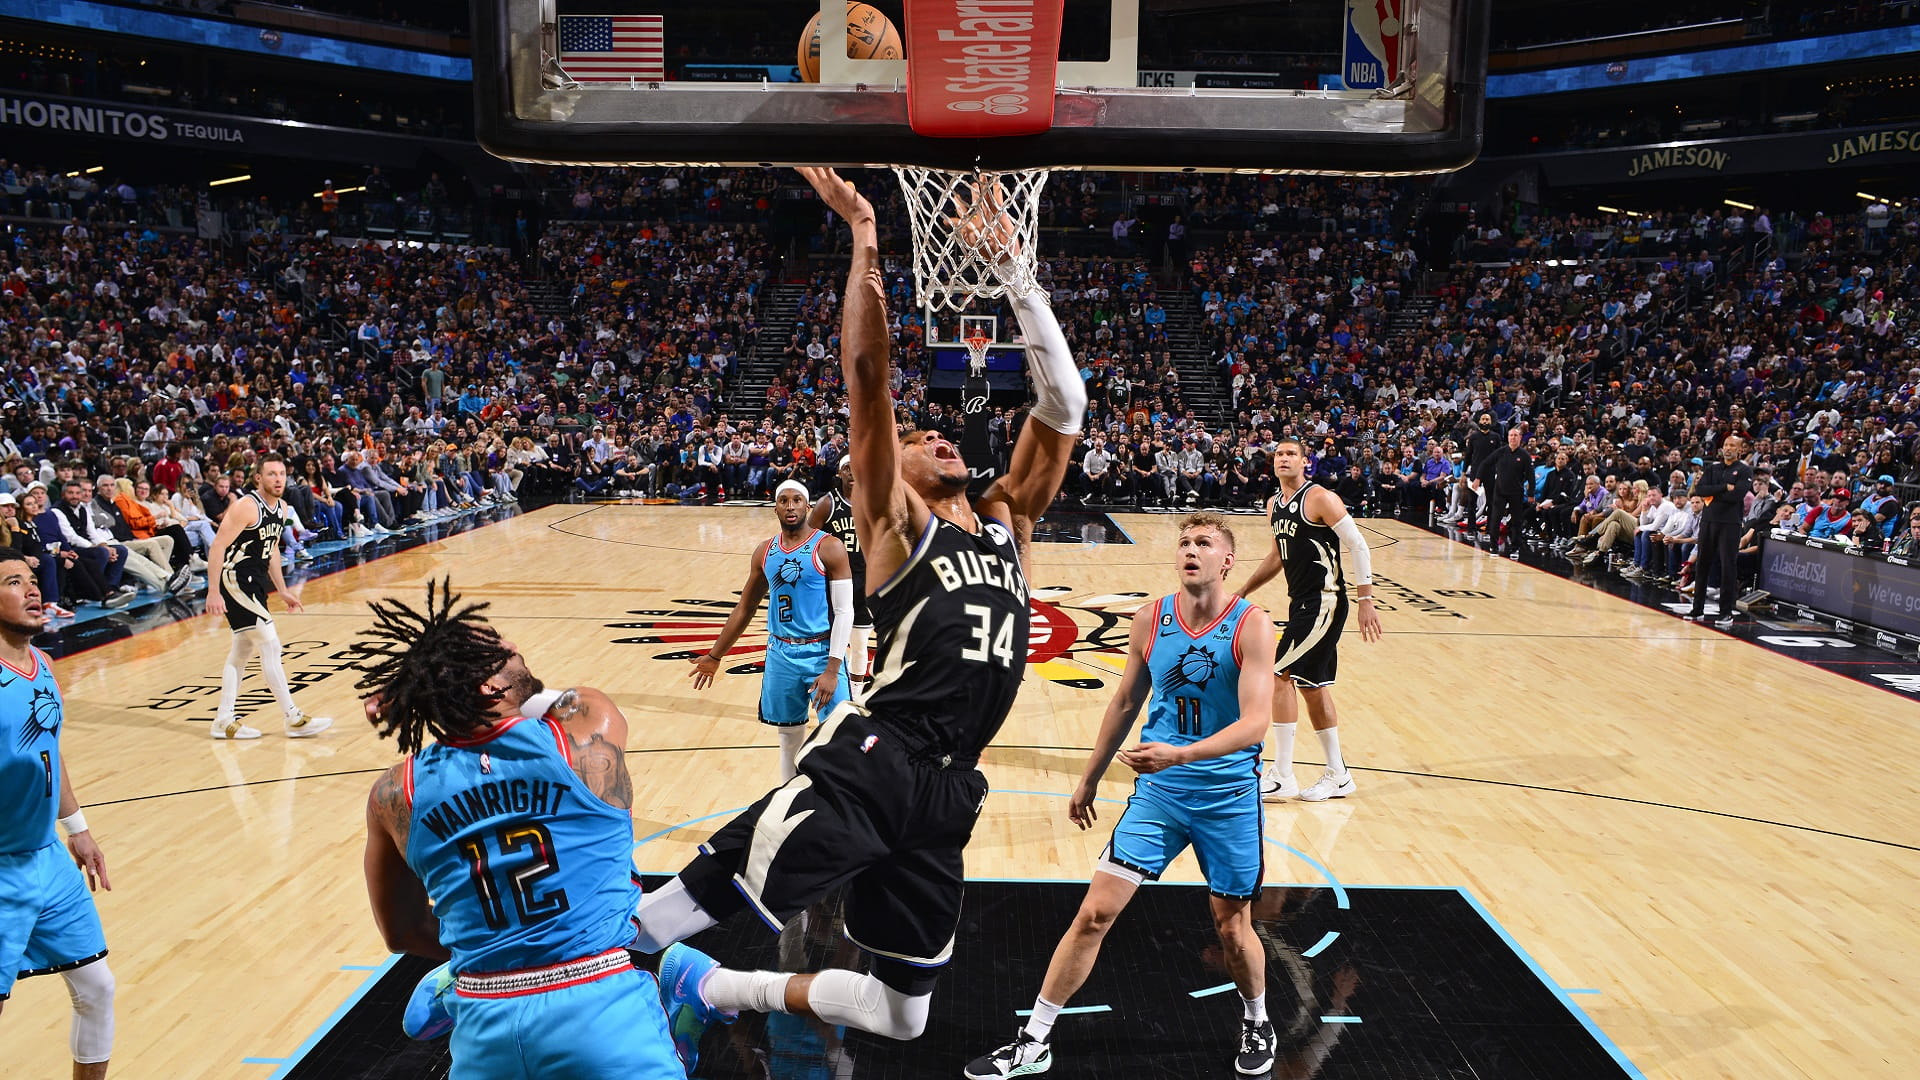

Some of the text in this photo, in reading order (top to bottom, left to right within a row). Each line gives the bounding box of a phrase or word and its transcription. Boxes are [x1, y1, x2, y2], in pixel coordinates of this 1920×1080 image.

[1351, 62, 1377, 83] NBA
[0, 98, 244, 143] HORNITOS TEQUILA
[1628, 147, 1727, 177] JAMESON
[1279, 539, 1288, 560] 11
[930, 550, 1025, 608] BUCKS
[1869, 583, 1901, 607] We're
[778, 595, 793, 622] 2
[1163, 615, 1171, 626] 6
[961, 603, 1015, 668] 34
[1175, 695, 1202, 737] 11
[40, 750, 52, 798] 1
[421, 778, 571, 843] WAINRIGHT
[457, 822, 570, 931] 12
